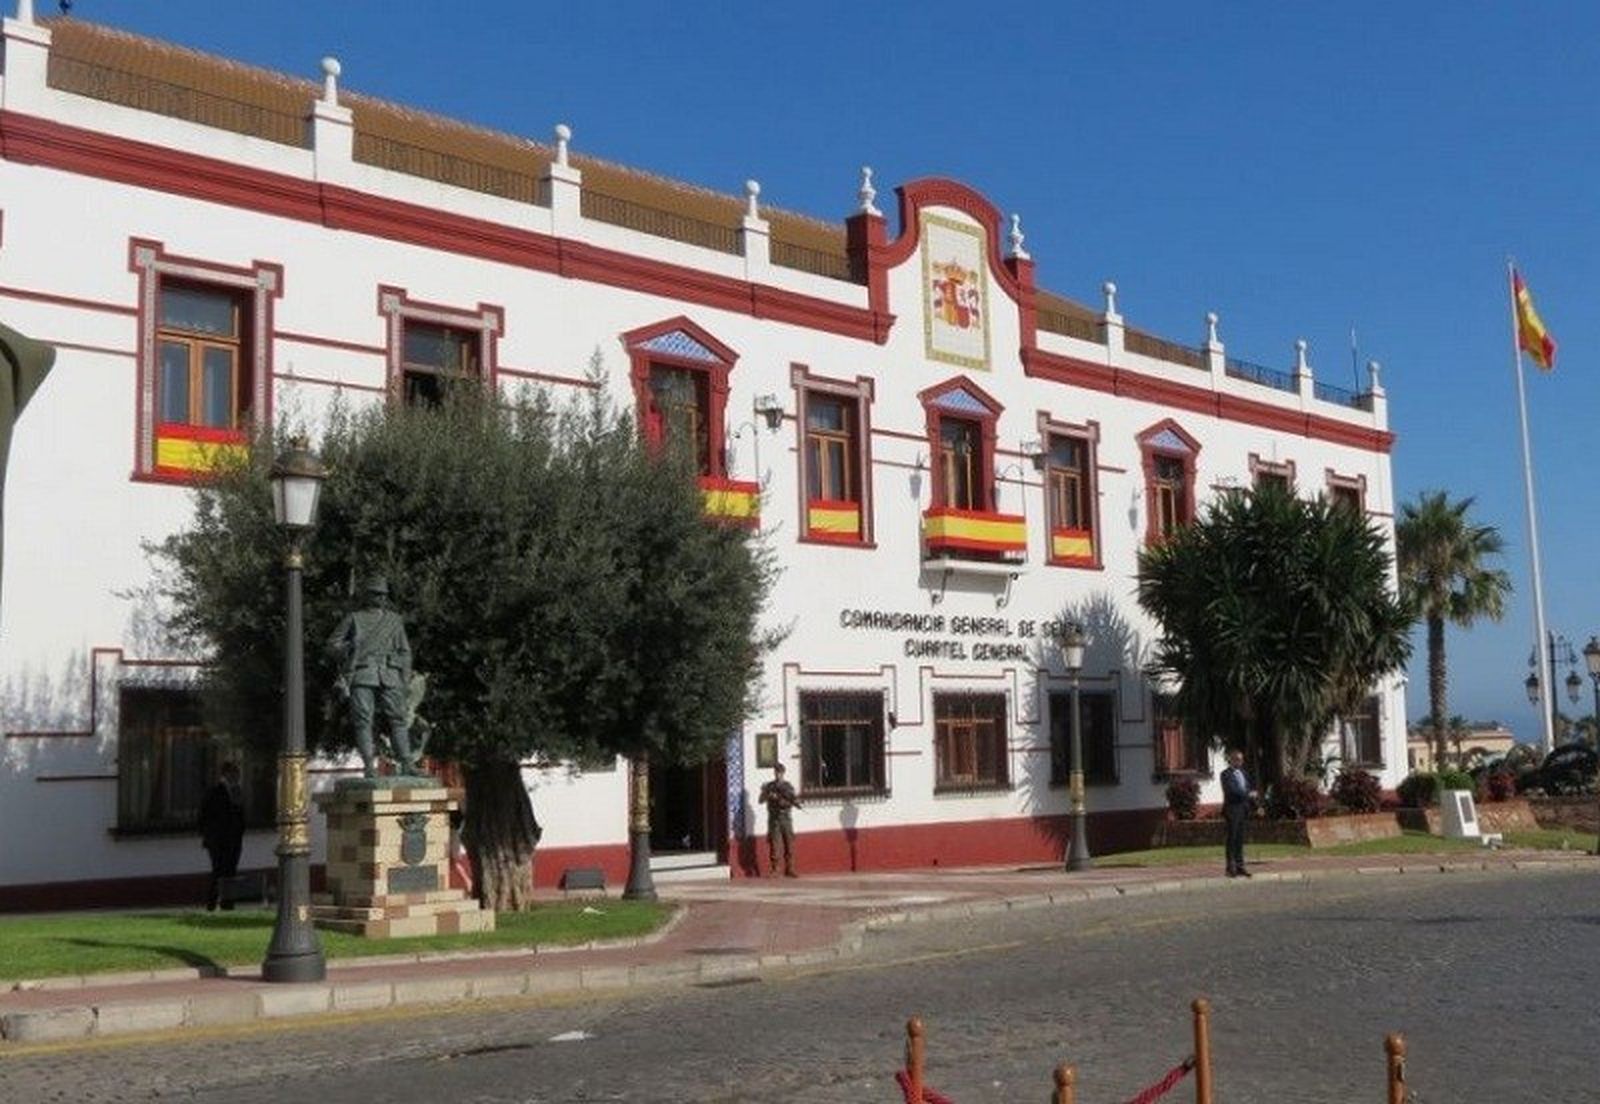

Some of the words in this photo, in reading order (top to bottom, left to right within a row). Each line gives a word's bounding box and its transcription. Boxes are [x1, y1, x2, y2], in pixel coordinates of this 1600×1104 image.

[841, 609, 944, 632] COMANDANCIA
[950, 616, 1013, 637] GENERAL
[1018, 621, 1036, 638] DE
[905, 639, 968, 660] CUARTEL
[972, 643, 1031, 662] GENERAL
